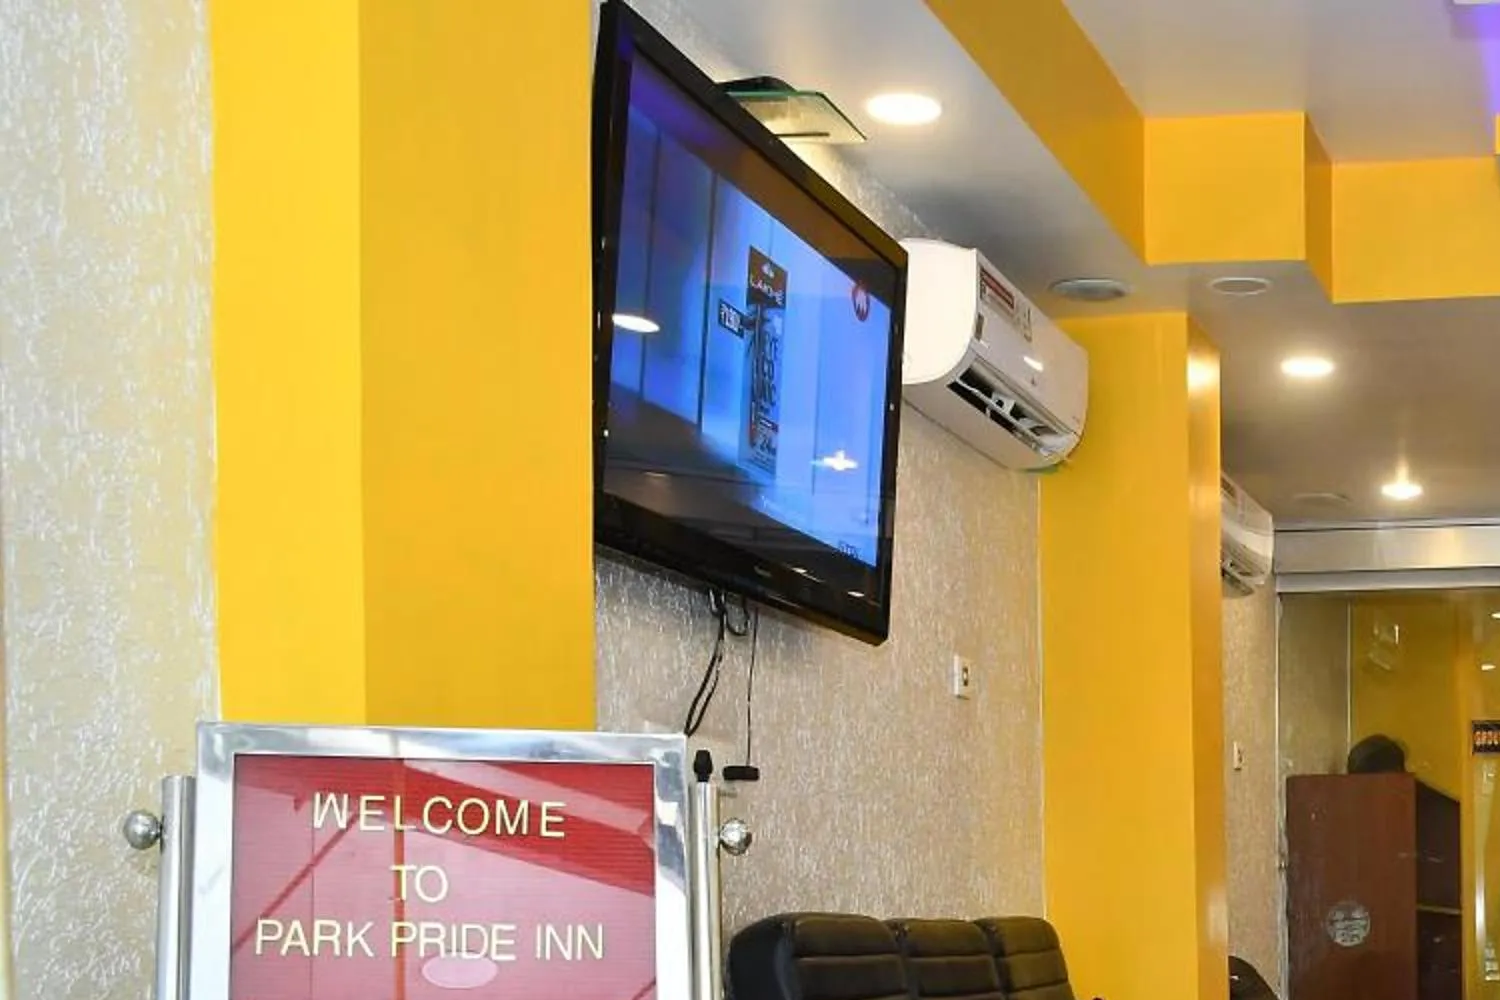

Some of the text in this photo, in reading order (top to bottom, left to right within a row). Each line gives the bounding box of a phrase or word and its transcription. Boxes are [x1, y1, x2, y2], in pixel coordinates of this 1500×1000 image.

[312, 793, 568, 838] WELCOME
[390, 865, 449, 904] TO
[254, 919, 606, 960] PARK PRIDE INN
